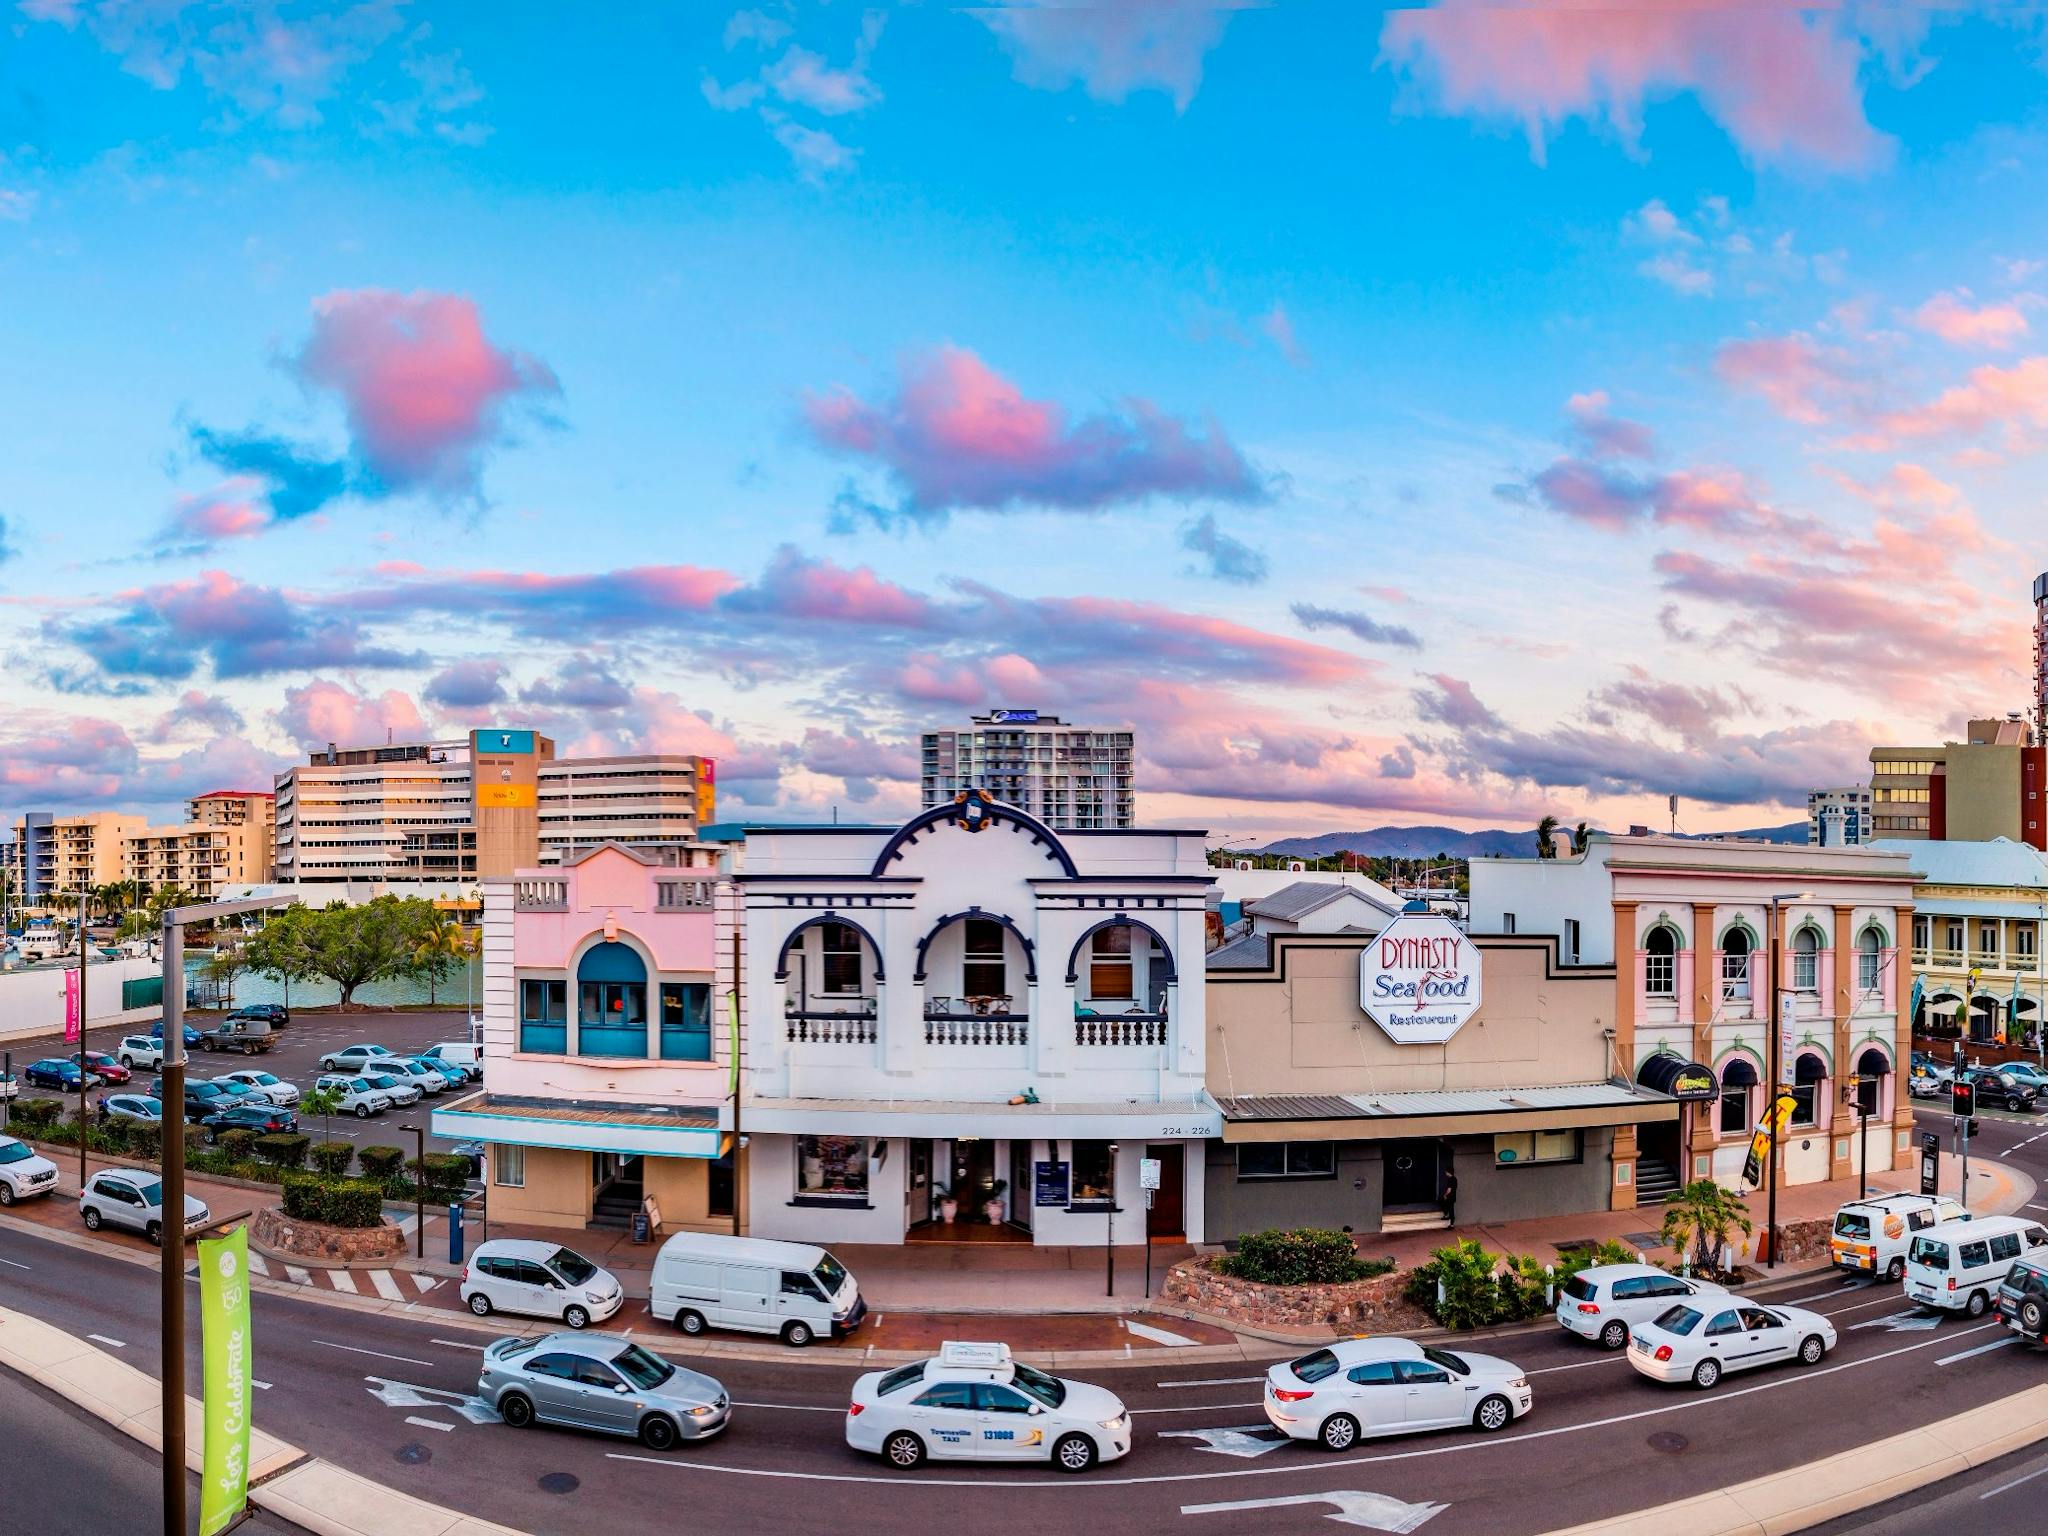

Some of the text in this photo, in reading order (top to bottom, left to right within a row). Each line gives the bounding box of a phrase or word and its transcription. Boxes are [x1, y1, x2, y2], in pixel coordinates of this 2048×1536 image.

[502, 735, 511, 746] T
[1381, 937, 1462, 969] DYNASTY
[1372, 971, 1470, 1004] Seafood
[1389, 1013, 1458, 1026] Restaurant
[1162, 1127, 1181, 1135] 224
[1191, 1127, 1211, 1135] 226
[224, 1325, 244, 1434] Celebrate
[930, 1428, 971, 1436] Townsville
[220, 1442, 243, 1494] Let's
